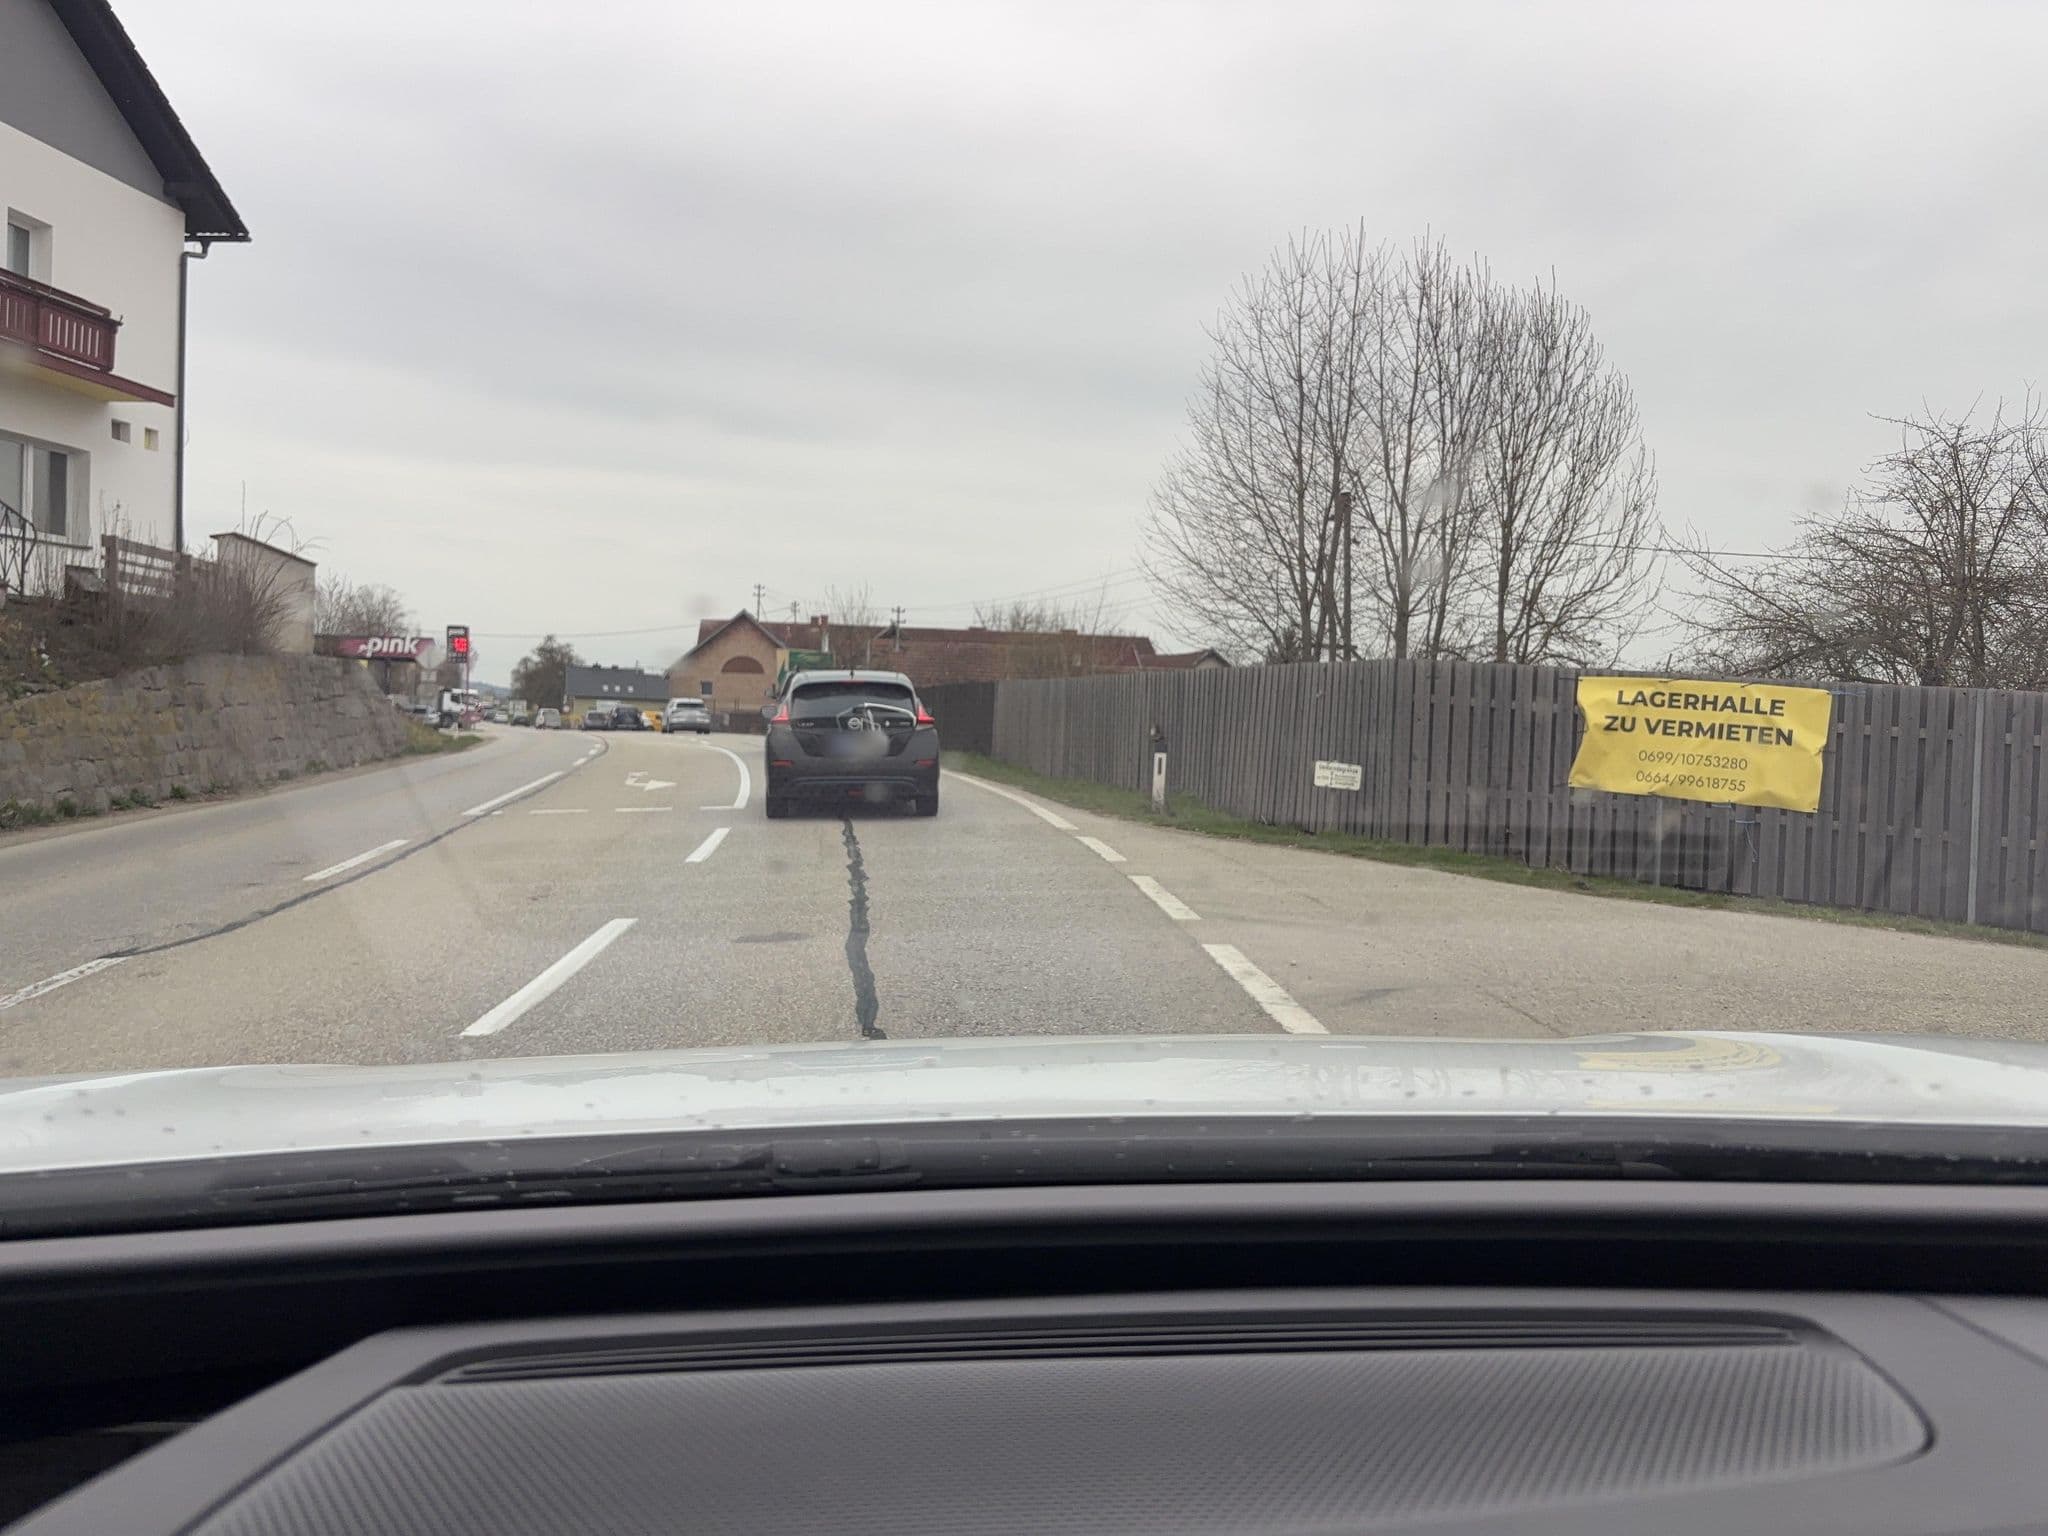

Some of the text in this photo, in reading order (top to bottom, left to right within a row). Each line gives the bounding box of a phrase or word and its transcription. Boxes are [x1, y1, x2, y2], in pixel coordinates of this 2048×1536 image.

[366, 632, 419, 658] pink
[1617, 690, 1786, 717] LAGERHALLE
[1603, 715, 1794, 747] ZU VERMIETEN
[1638, 750, 1748, 771] 0699/10753280
[1636, 770, 1746, 792] 0664/99618755
